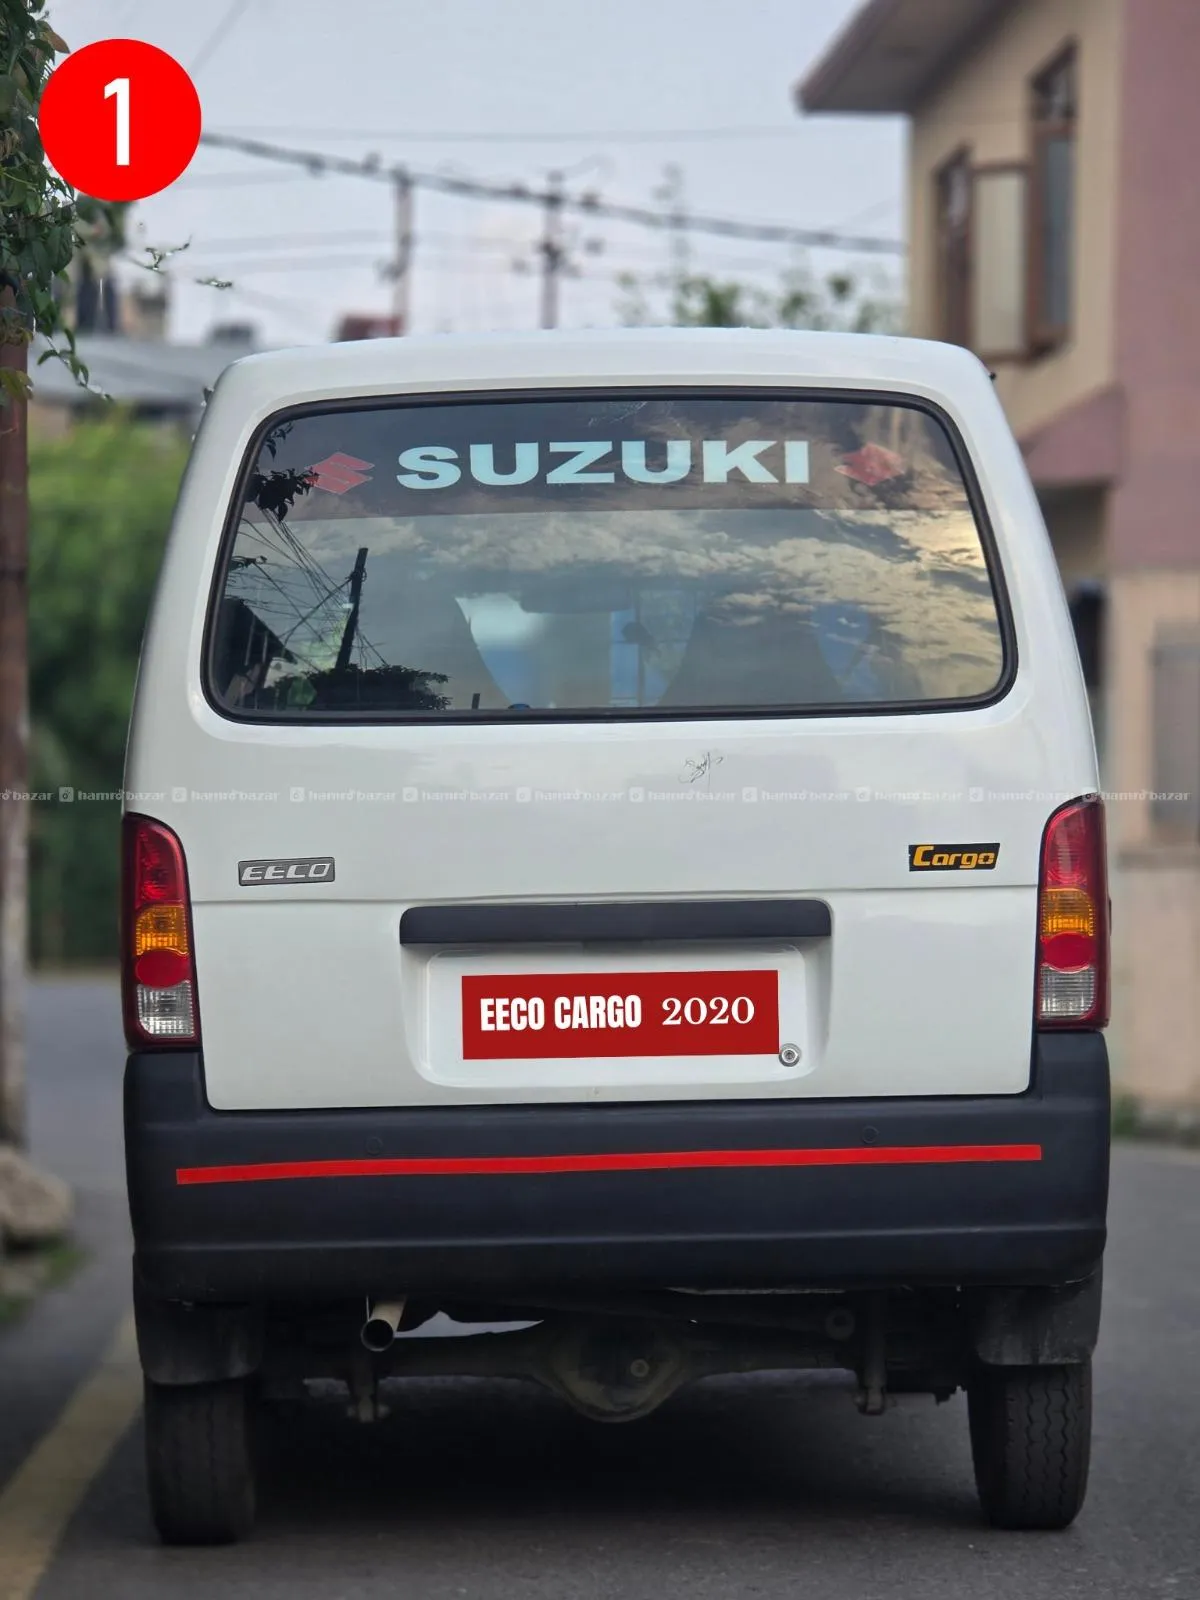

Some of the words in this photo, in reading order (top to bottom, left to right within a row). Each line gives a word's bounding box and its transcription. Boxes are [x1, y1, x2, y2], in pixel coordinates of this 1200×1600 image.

[396, 440, 810, 490] SUZUKI
[913, 845, 996, 869] Cargo
[241, 862, 332, 881] EECO
